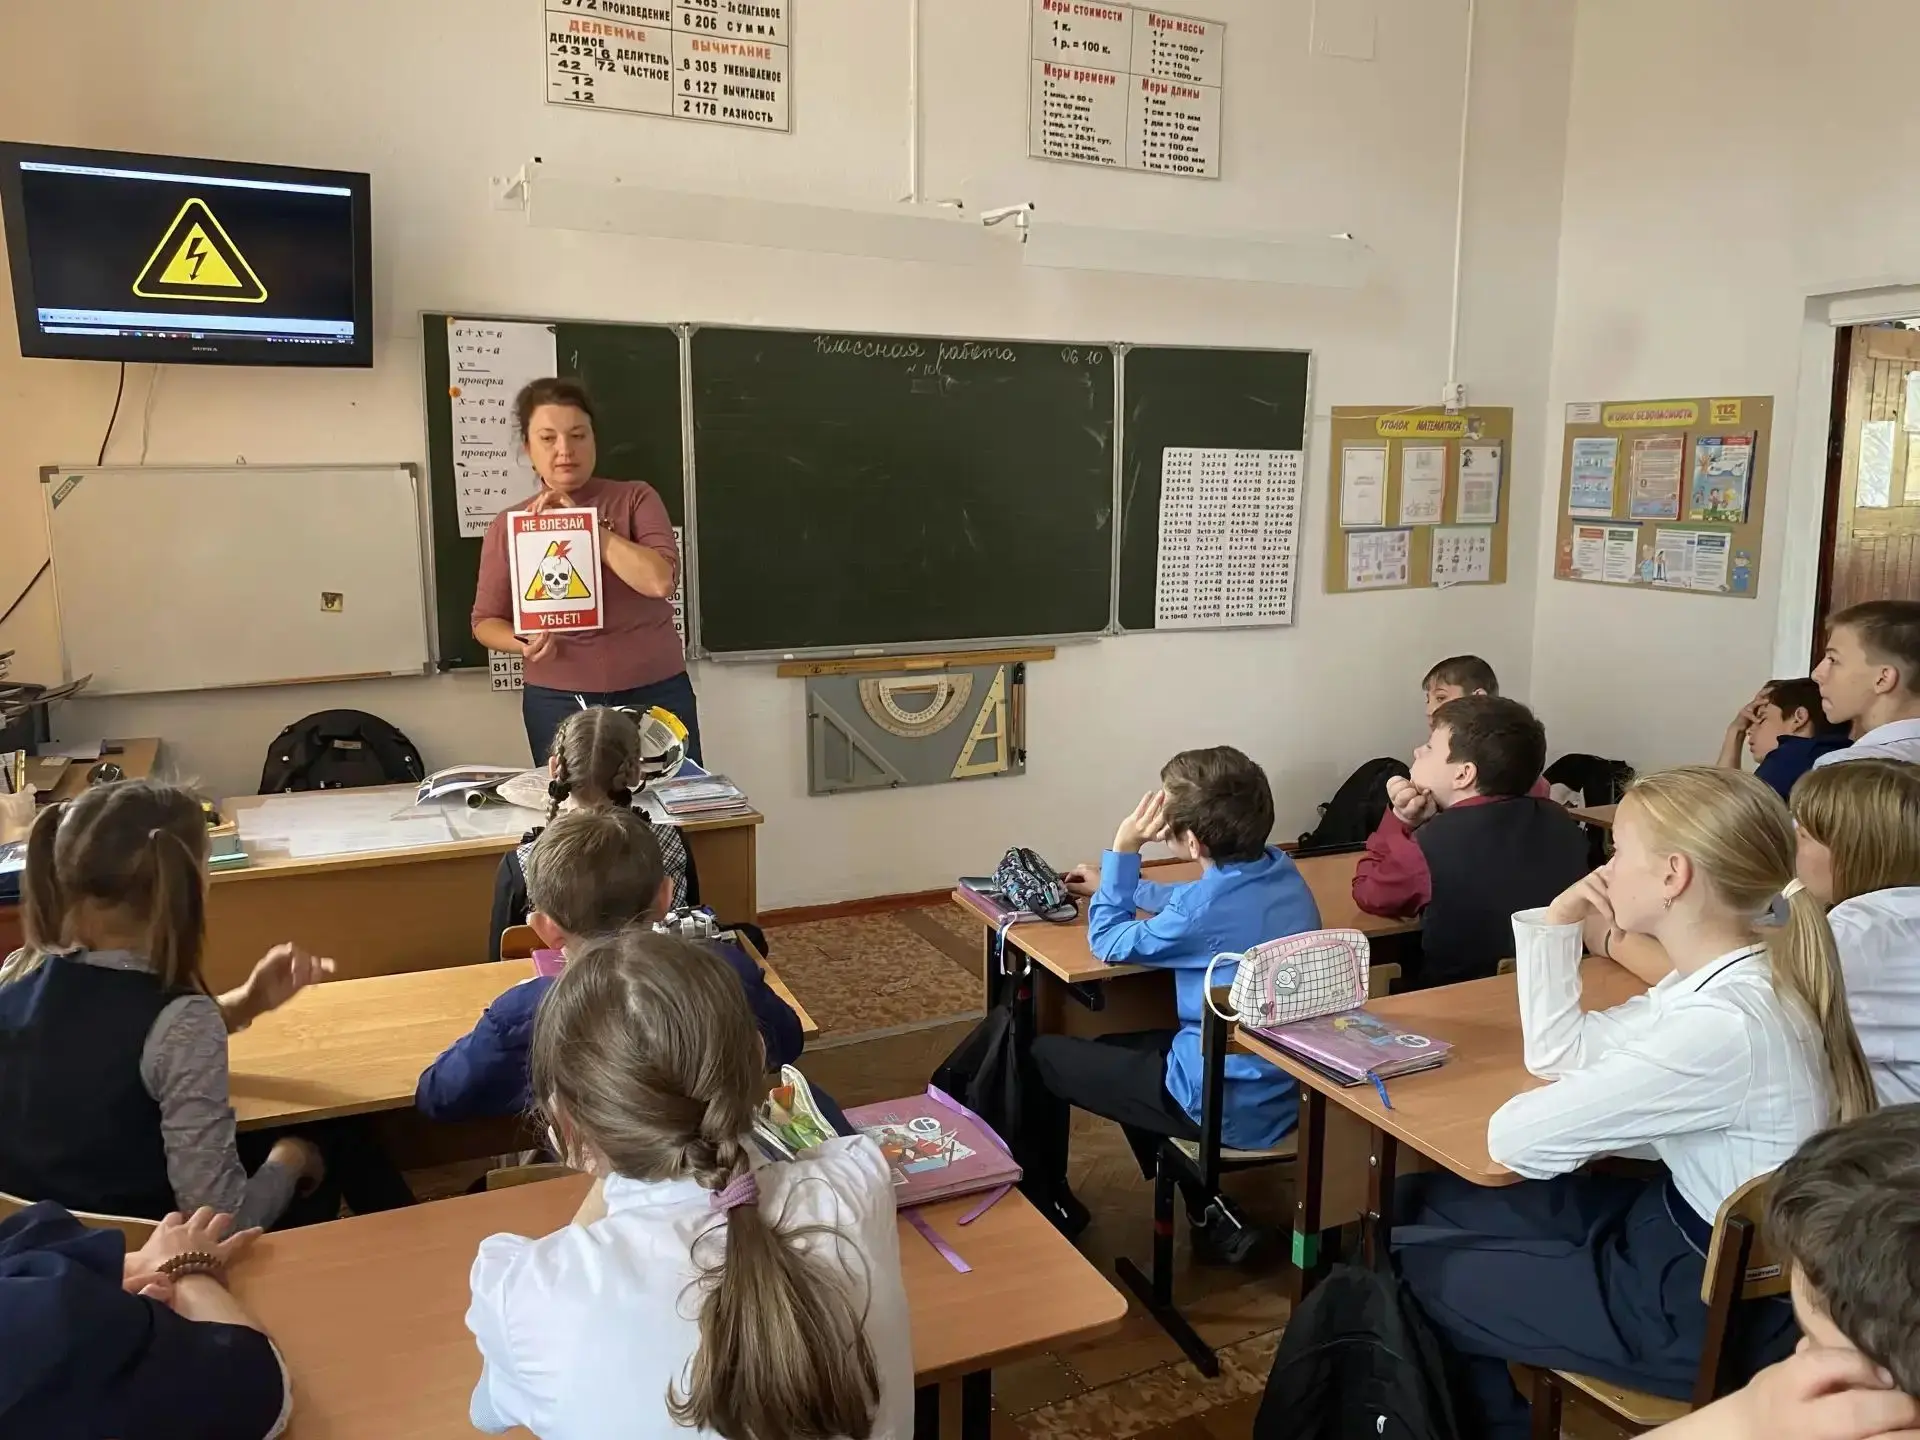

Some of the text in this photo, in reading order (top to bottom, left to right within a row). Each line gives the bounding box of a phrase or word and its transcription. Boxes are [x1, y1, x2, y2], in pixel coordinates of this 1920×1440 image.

[601, 1, 670, 22] ПРОИЗВЕДЕНИЕ
[737, 3, 780, 18] СЛАГАЕМОЕ
[1043, 0, 1123, 21] Меры стоимости
[684, 13, 690, 26] 6
[696, 15, 716, 30] 206
[1053, 20, 1058, 29] 1
[1149, 13, 1206, 35] Меры массы
[568, 18, 647, 43] ДЕЛЕНИЕ
[550, 31, 604, 49] ДЕЛИМОЕ
[1053, 37, 1057, 46] 1
[1082, 41, 1099, 52] 100
[1179, 44, 1198, 53] 1000
[557, 44, 669, 65] 432 6 ДЕЛИТЕЛЬ
[692, 38, 772, 60] ВЫЧИТАНИЕ
[1175, 53, 1189, 61] 100
[558, 60, 669, 81] 42 72 ЧАСТНОЕ
[684, 58, 781, 82] 8 305 УМЕНЬШАЕМОЕ
[1044, 63, 1117, 85] Меры времени
[572, 76, 594, 86] 12
[1142, 78, 1199, 99] Меры длины
[571, 91, 594, 101] 12
[684, 79, 775, 102] 6 127 ВЫЧИТАЕМОЕ
[684, 100, 773, 122] 2 178 РАЗНОСТЬ
[1168, 143, 1184, 151] 100
[813, 335, 1016, 370] Классная работа
[458, 378, 503, 387] проверка
[461, 450, 507, 459] проверка
[521, 515, 584, 531] НЕ ВЛЕЗАЙ
[538, 612, 581, 626] УБЬЕТ!
[494, 662, 507, 671] 81
[494, 679, 508, 688] 91
